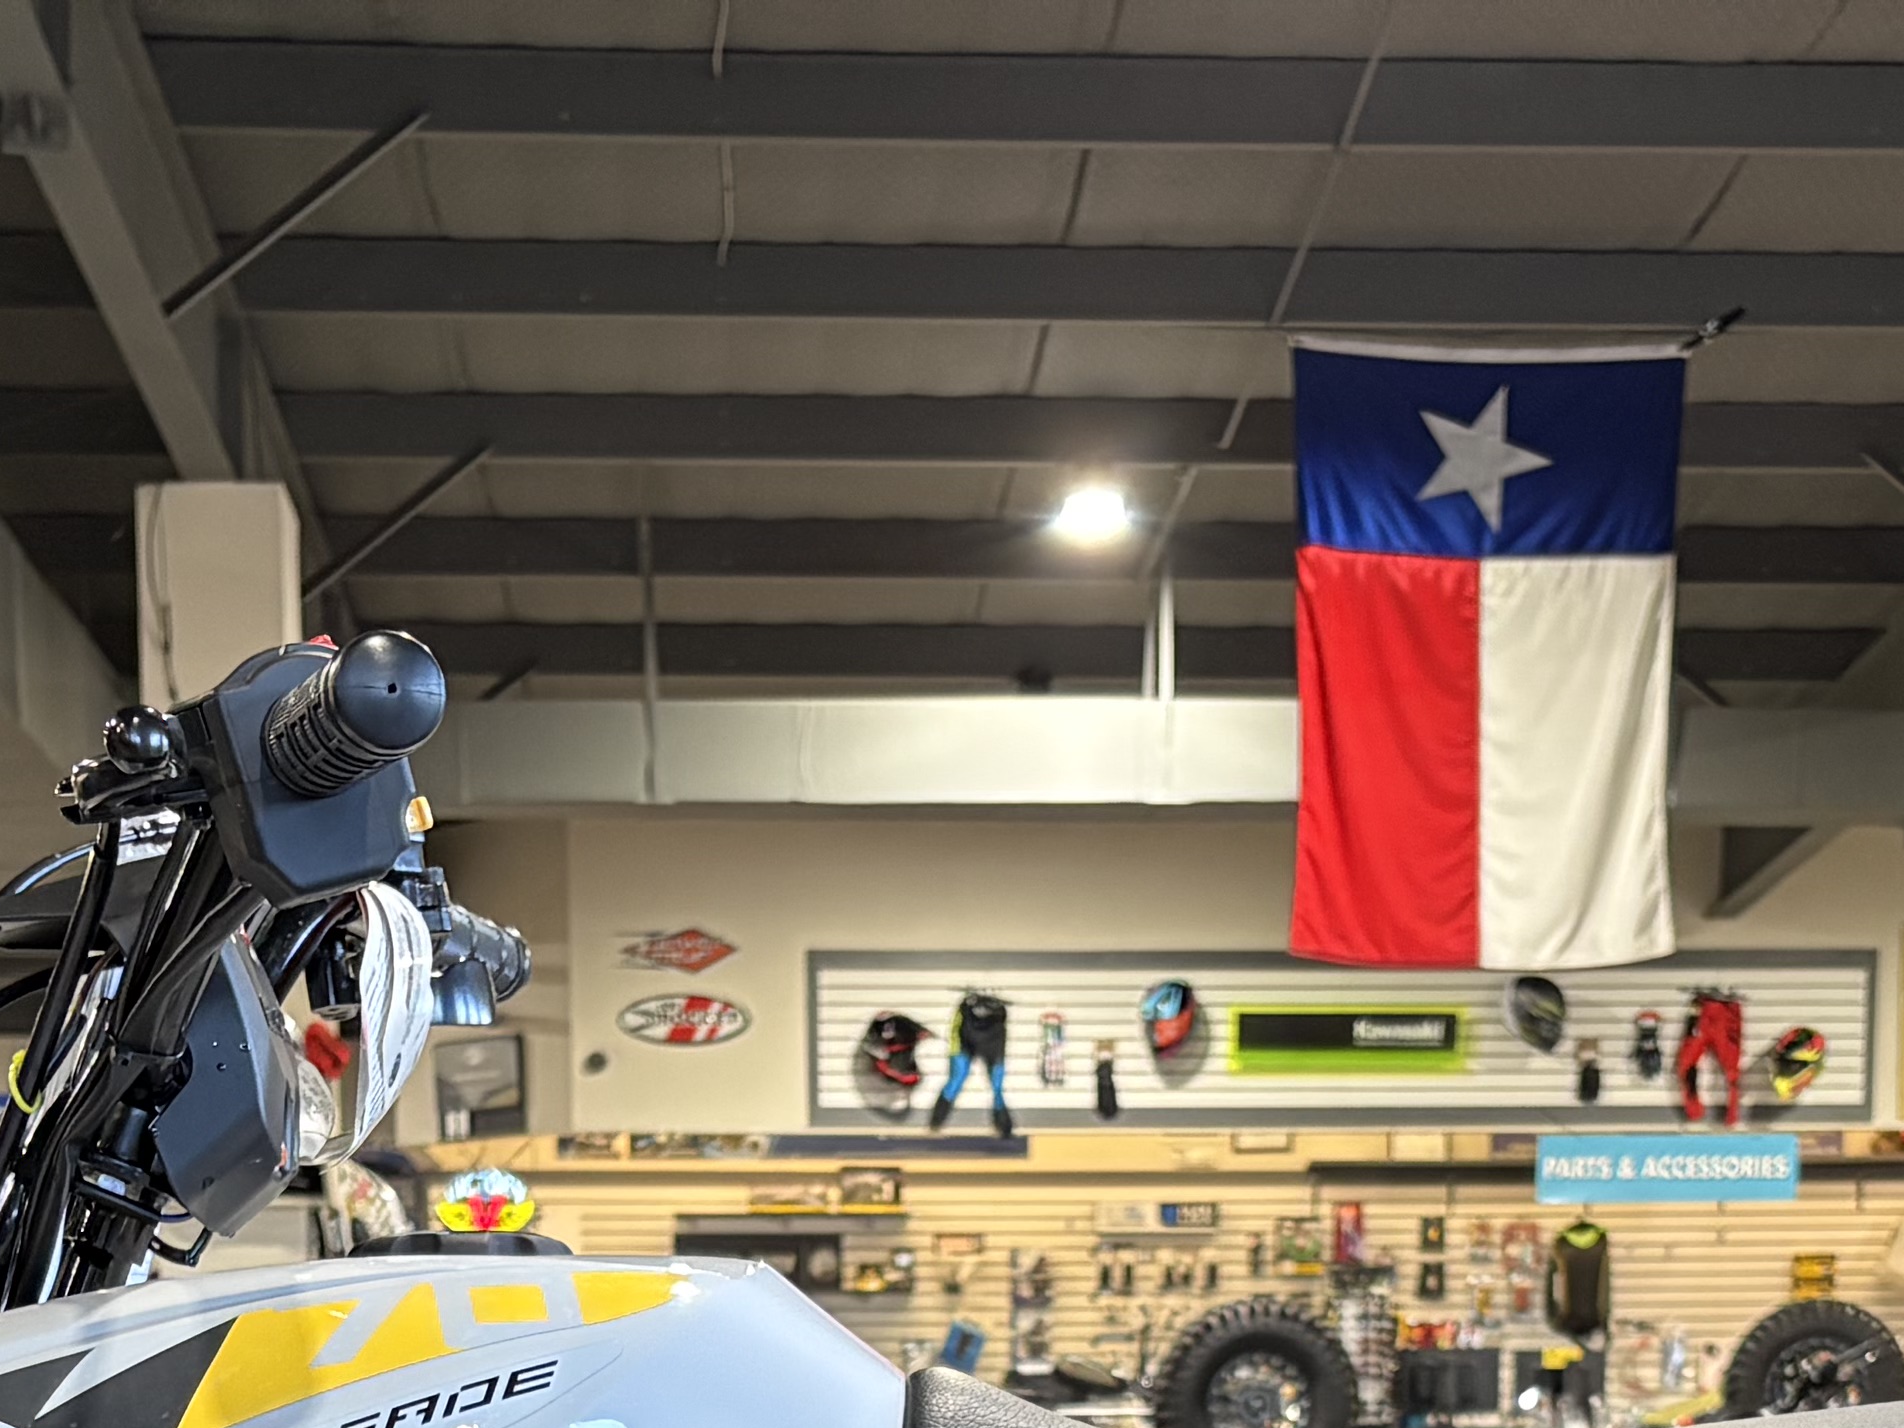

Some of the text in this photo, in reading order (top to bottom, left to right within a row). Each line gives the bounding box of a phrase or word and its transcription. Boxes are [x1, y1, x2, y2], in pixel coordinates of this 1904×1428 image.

[1541, 1154, 1790, 1180] PARTS & ACCESSORIES
